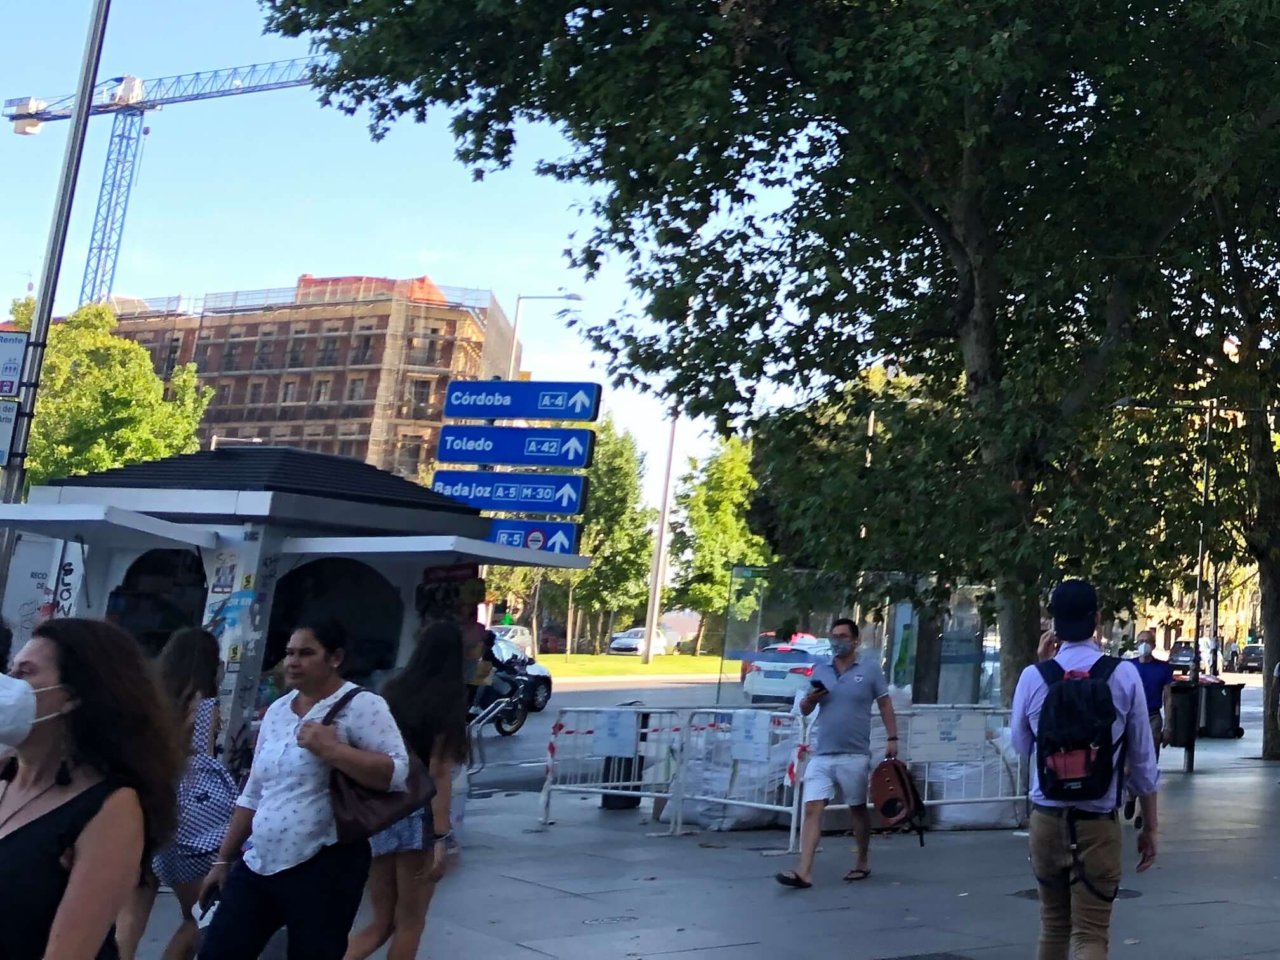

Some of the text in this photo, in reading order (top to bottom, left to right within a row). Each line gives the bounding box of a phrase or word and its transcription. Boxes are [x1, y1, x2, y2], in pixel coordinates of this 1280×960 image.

[451, 392, 564, 406] Córdoba A-4
[444, 437, 557, 453] Toledo A-42
[434, 481, 551, 499] Badajoz A-5 M-30
[500, 533, 521, 546] R-5
